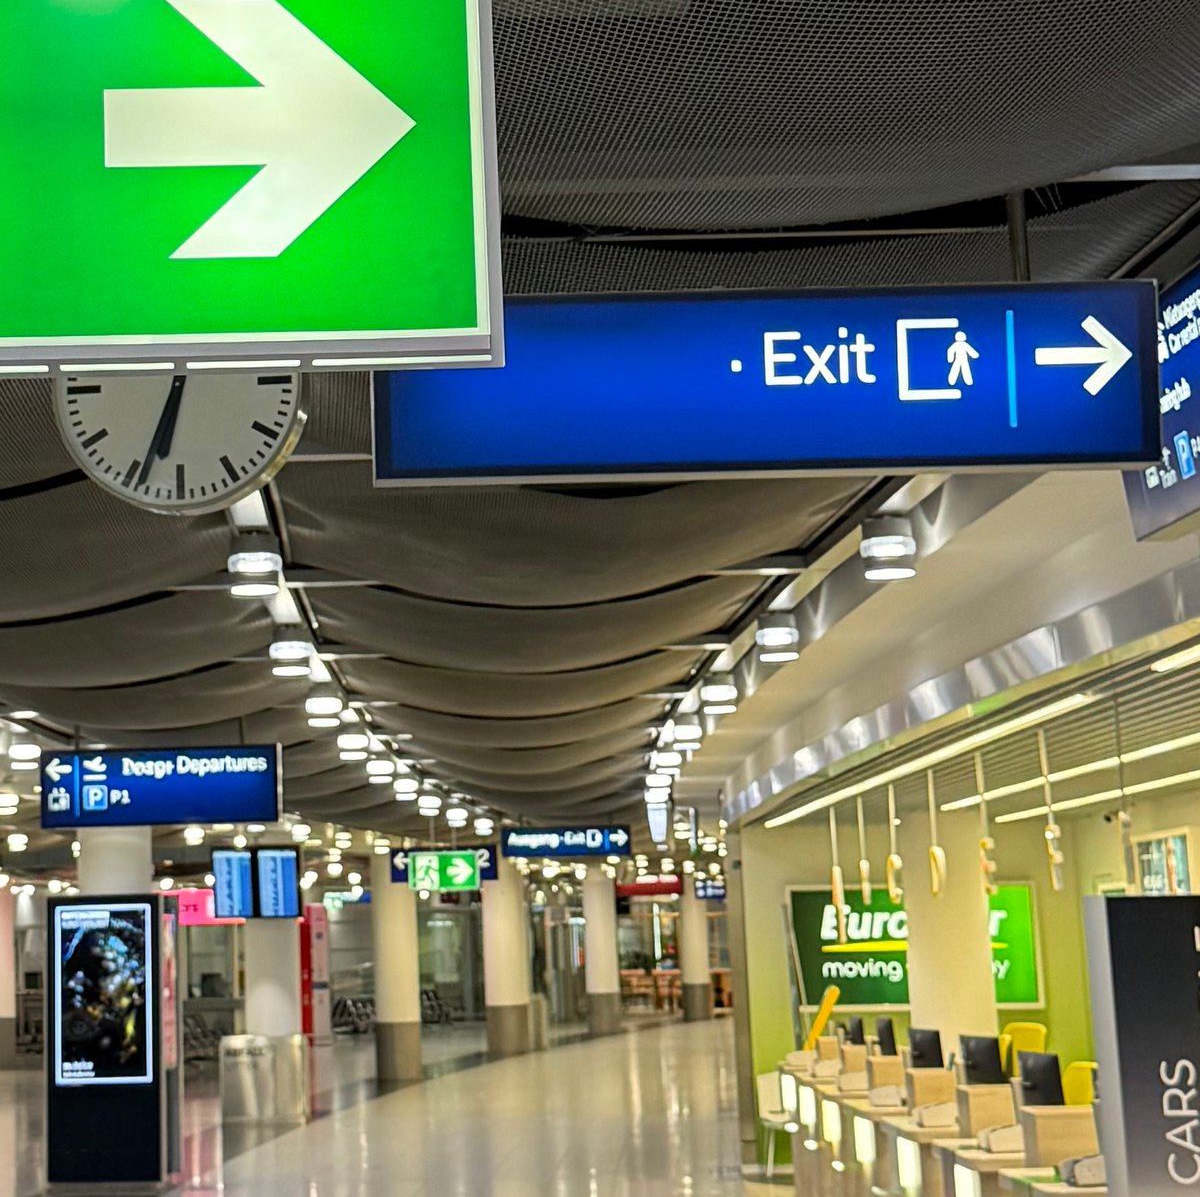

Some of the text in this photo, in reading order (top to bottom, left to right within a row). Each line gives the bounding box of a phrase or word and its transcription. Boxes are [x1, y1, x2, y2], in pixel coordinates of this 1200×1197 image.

[763, 327, 877, 386] Exit
[176, 755, 268, 777] Departures
[821, 904, 1008, 940] Euror
[822, 958, 903, 982] moving
[1160, 1059, 1200, 1185] CARS
